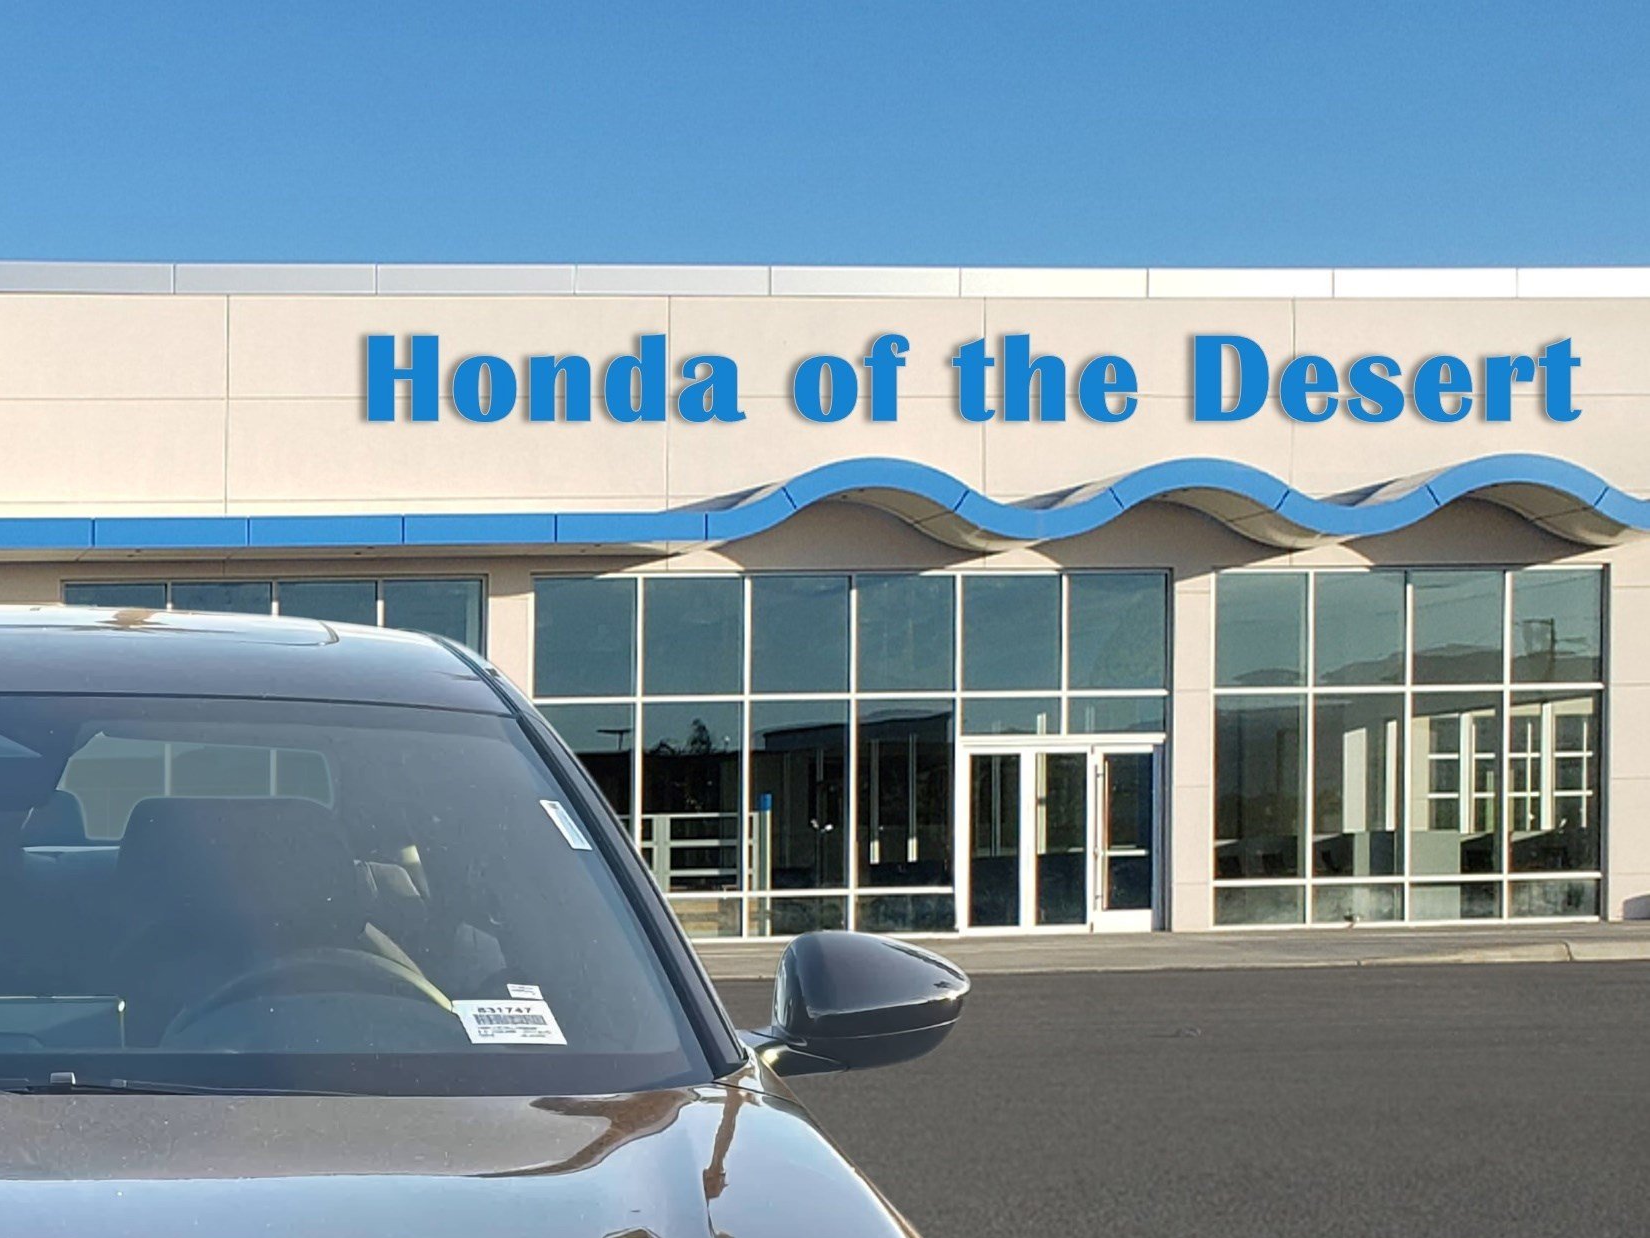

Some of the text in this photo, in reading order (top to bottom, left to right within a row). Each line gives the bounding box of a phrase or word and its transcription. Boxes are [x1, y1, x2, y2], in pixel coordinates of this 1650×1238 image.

[365, 333, 1583, 423] Honda of the Desert
